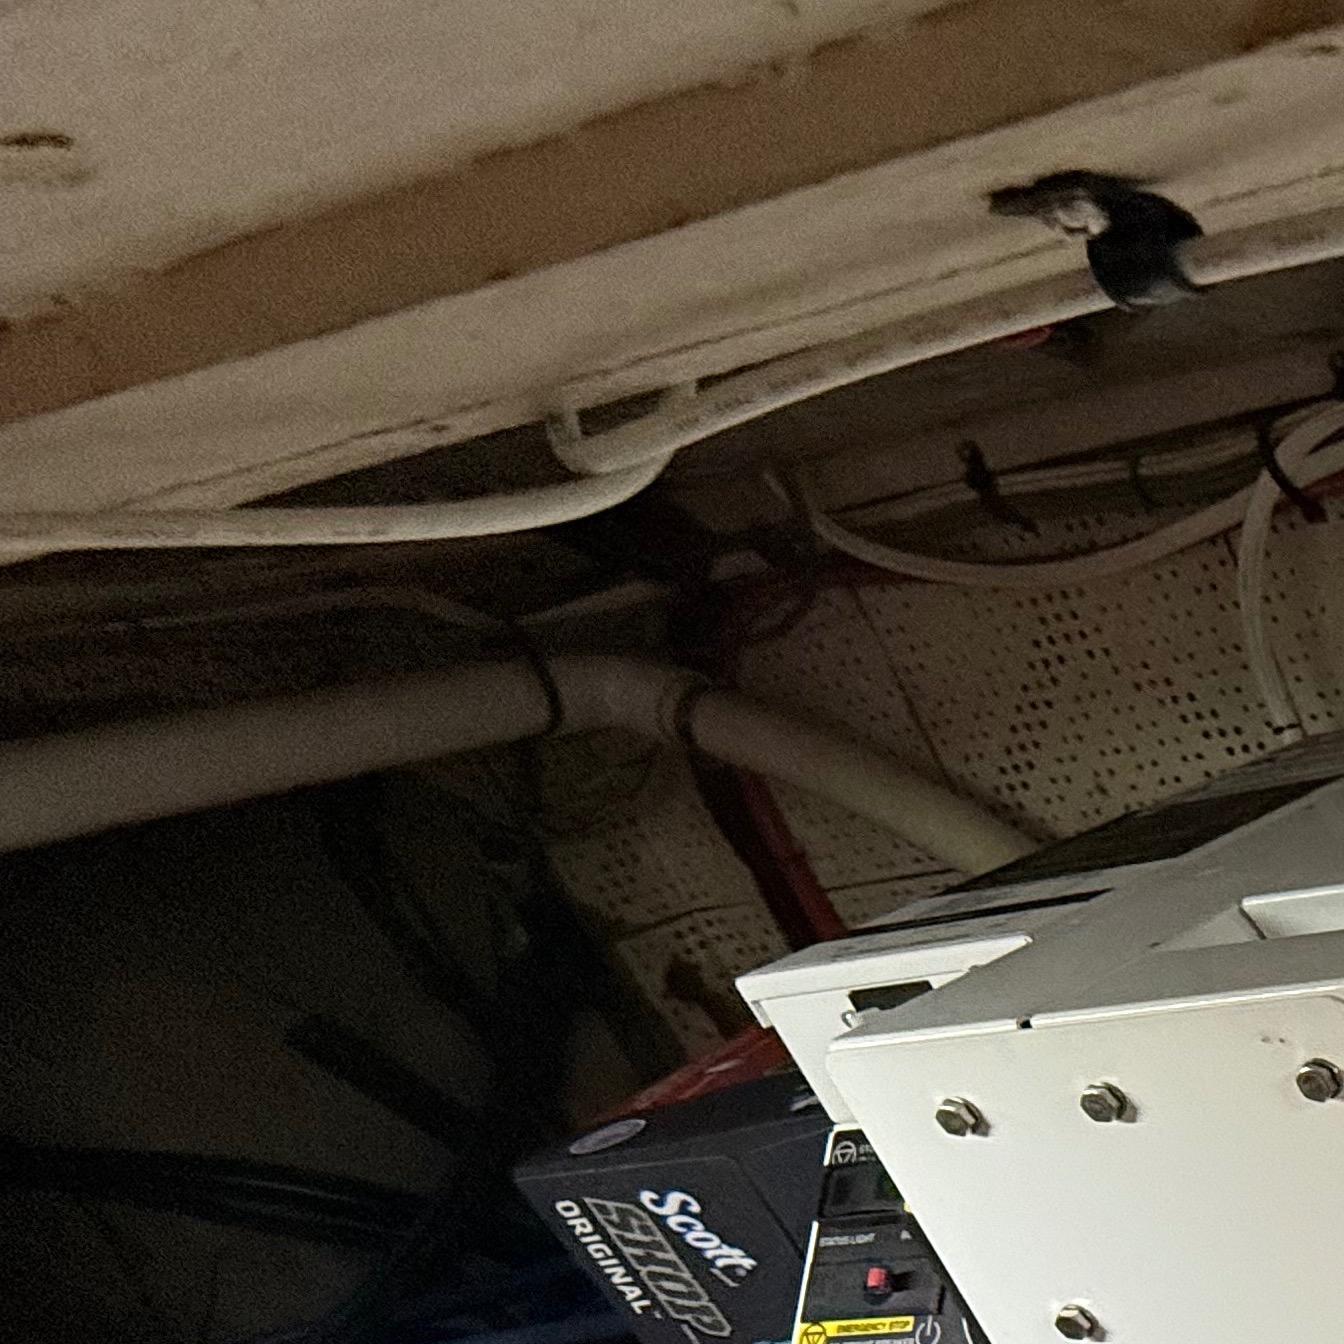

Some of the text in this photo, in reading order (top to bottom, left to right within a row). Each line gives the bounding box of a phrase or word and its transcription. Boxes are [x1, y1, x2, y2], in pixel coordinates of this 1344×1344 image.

[555, 1200, 651, 1315] ORIGINAL
[583, 1197, 732, 1337] SHOP
[640, 1189, 757, 1270] Scott
